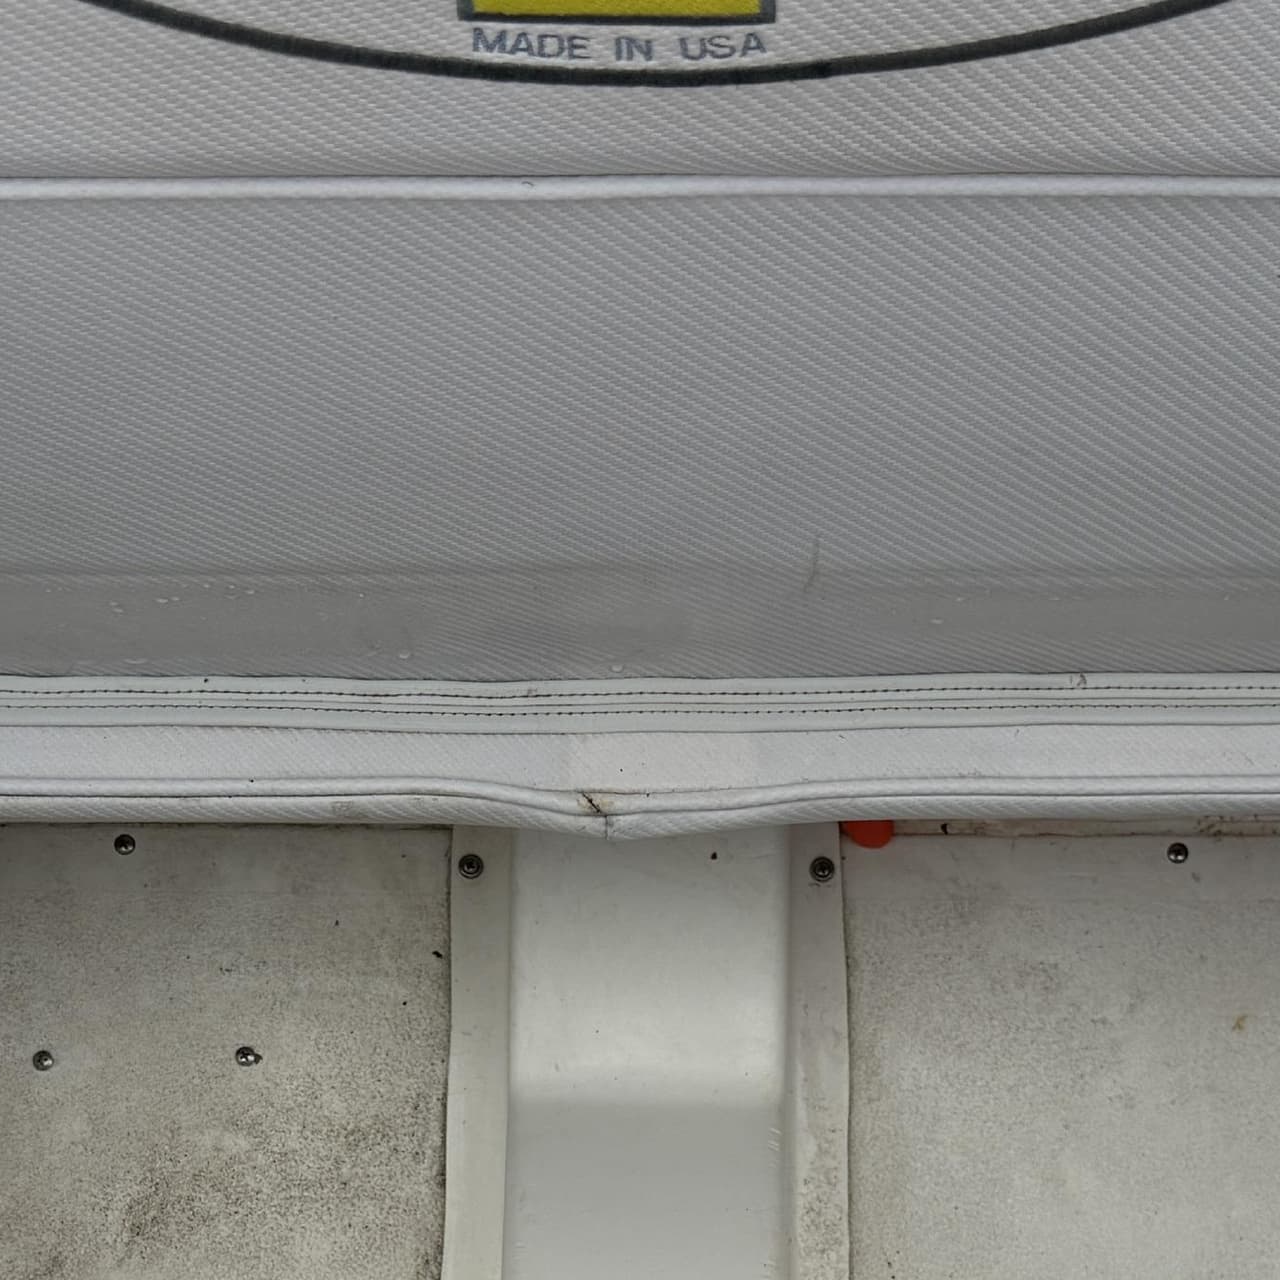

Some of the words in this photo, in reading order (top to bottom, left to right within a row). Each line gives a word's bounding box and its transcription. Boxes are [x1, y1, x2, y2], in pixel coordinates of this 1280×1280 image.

[471, 26, 593, 60] MADE
[614, 36, 654, 62] IN
[679, 32, 768, 61] USA
